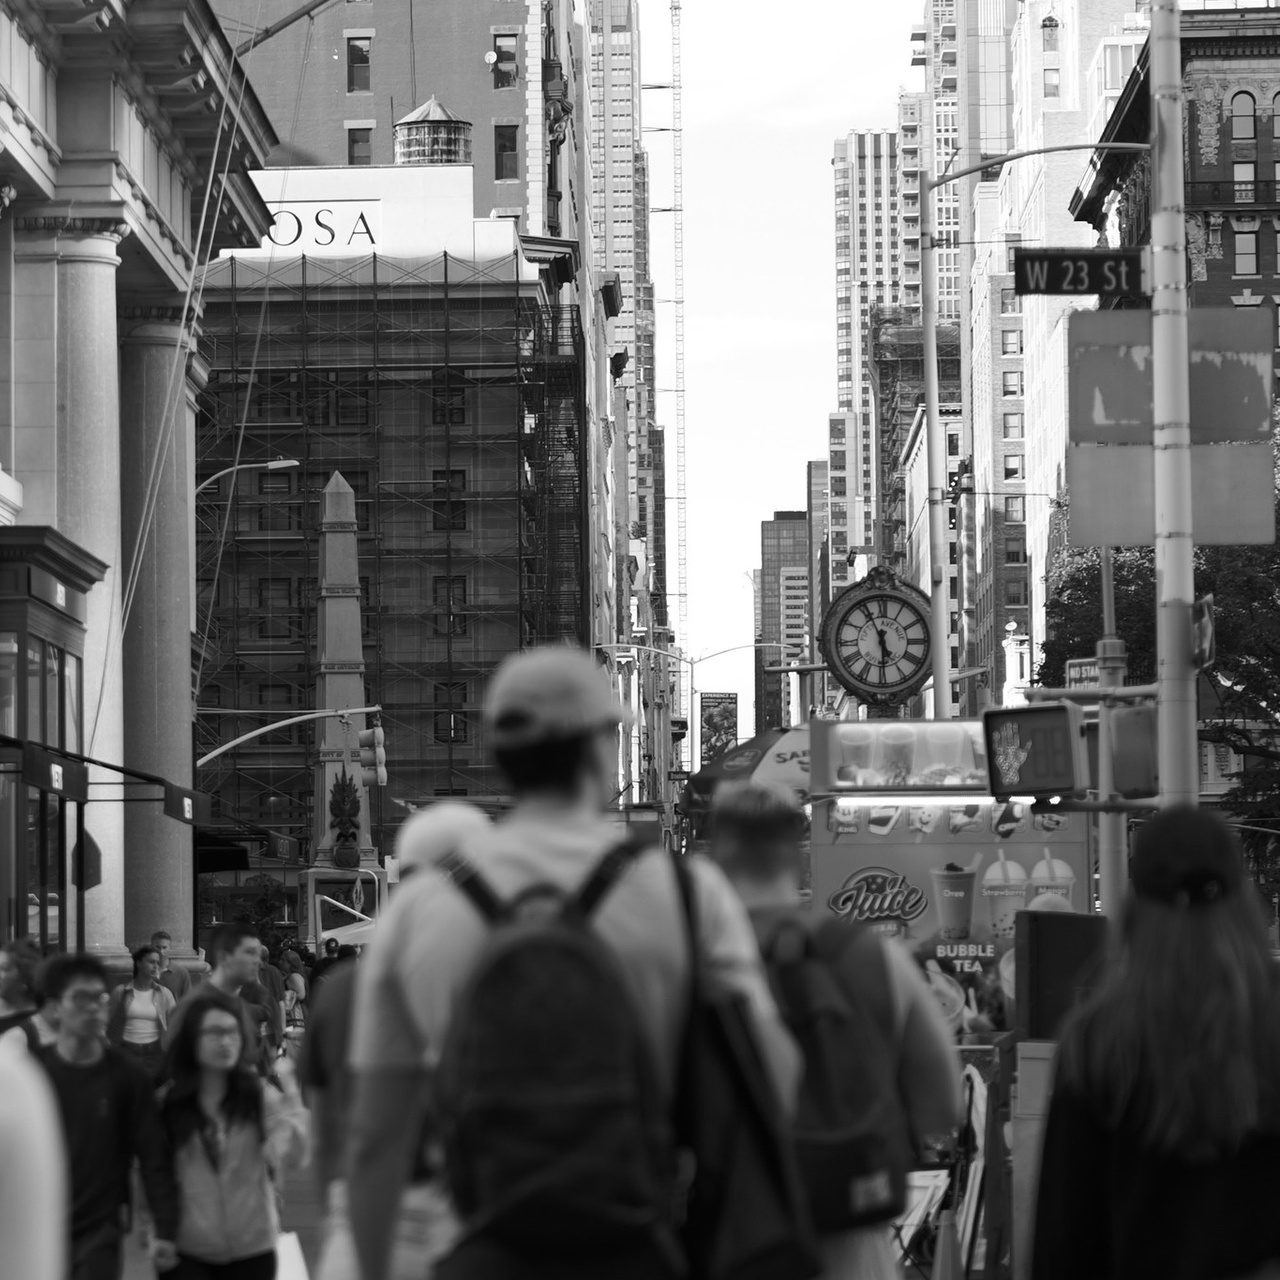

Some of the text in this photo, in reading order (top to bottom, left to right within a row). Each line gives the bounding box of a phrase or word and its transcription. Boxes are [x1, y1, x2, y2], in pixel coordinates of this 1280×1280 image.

[267, 209, 376, 246] OSA
[1026, 260, 1129, 290] W 23 St
[880, 620, 905, 642] AVENUE
[1070, 667, 1081, 679] NO
[828, 874, 928, 923] Juice
[980, 888, 1026, 898] Strawberry
[936, 944, 995, 957] BUBBLE
[953, 959, 983, 972] TEA
